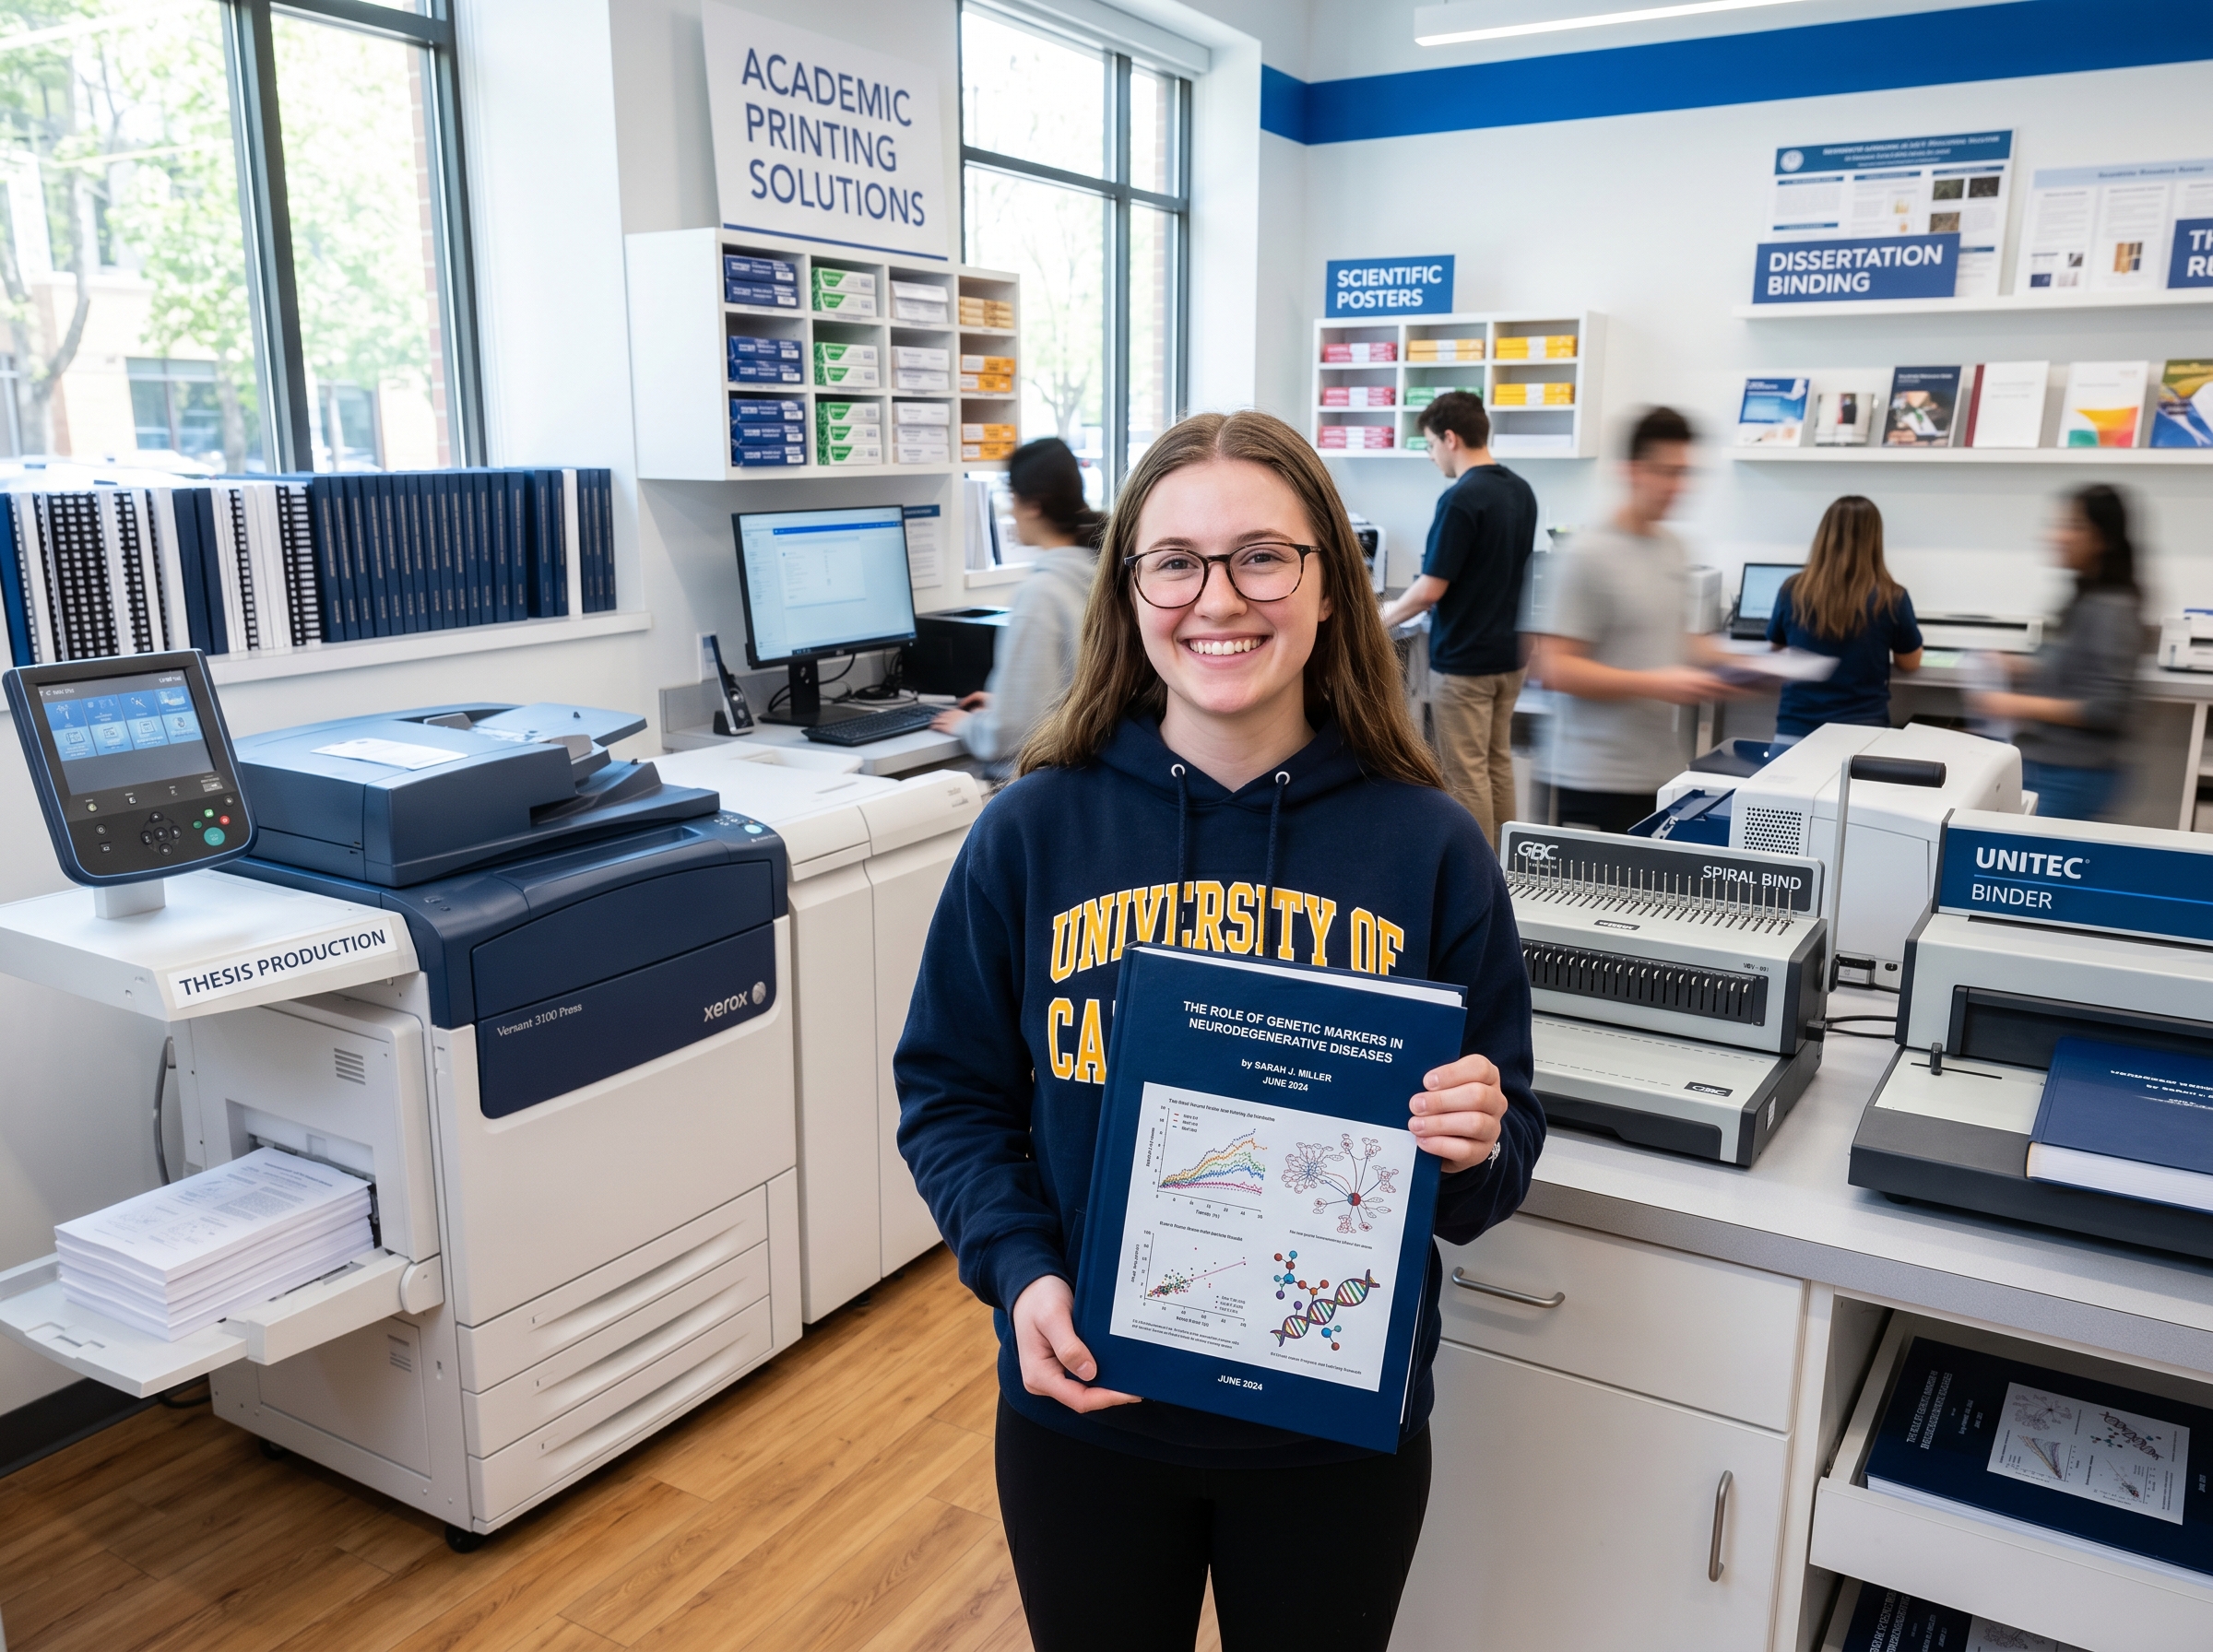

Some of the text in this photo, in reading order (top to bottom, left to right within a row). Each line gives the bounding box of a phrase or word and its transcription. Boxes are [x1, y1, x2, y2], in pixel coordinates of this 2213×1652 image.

[741, 47, 912, 127] ACADEMIC
[745, 101, 897, 172] PRINTING
[749, 159, 925, 227] SOLUTIONS
[1769, 243, 1944, 273] DISSERTATION
[1336, 264, 1443, 289] SCIENTIFIC
[1767, 271, 1871, 296] BINDING
[1336, 288, 1424, 310] POSTERS
[1517, 841, 1558, 860] GBC
[1702, 865, 1803, 891] SPIRAL BIND
[1971, 883, 2053, 909] BINDER
[1049, 879, 1404, 984] UNIVERSITY OF
[179, 928, 386, 996] THESIS PRODUCTION
[535, 1009, 558, 1026] 3100
[559, 1003, 583, 1018] Press
[704, 990, 748, 1022] xerox
[1183, 1000, 1403, 1050] THE ROLE OF GENETIC MARKERS IN
[1047, 996, 1116, 1085] CA
[1189, 1017, 1393, 1064] NEURODEGENERATIVE DISEASES
[1241, 1058, 1332, 1083] by SARAH J. MILLER
[1262, 1076, 1308, 1092] JUNE 2024
[1217, 1375, 1263, 1391] JUNE 2024
